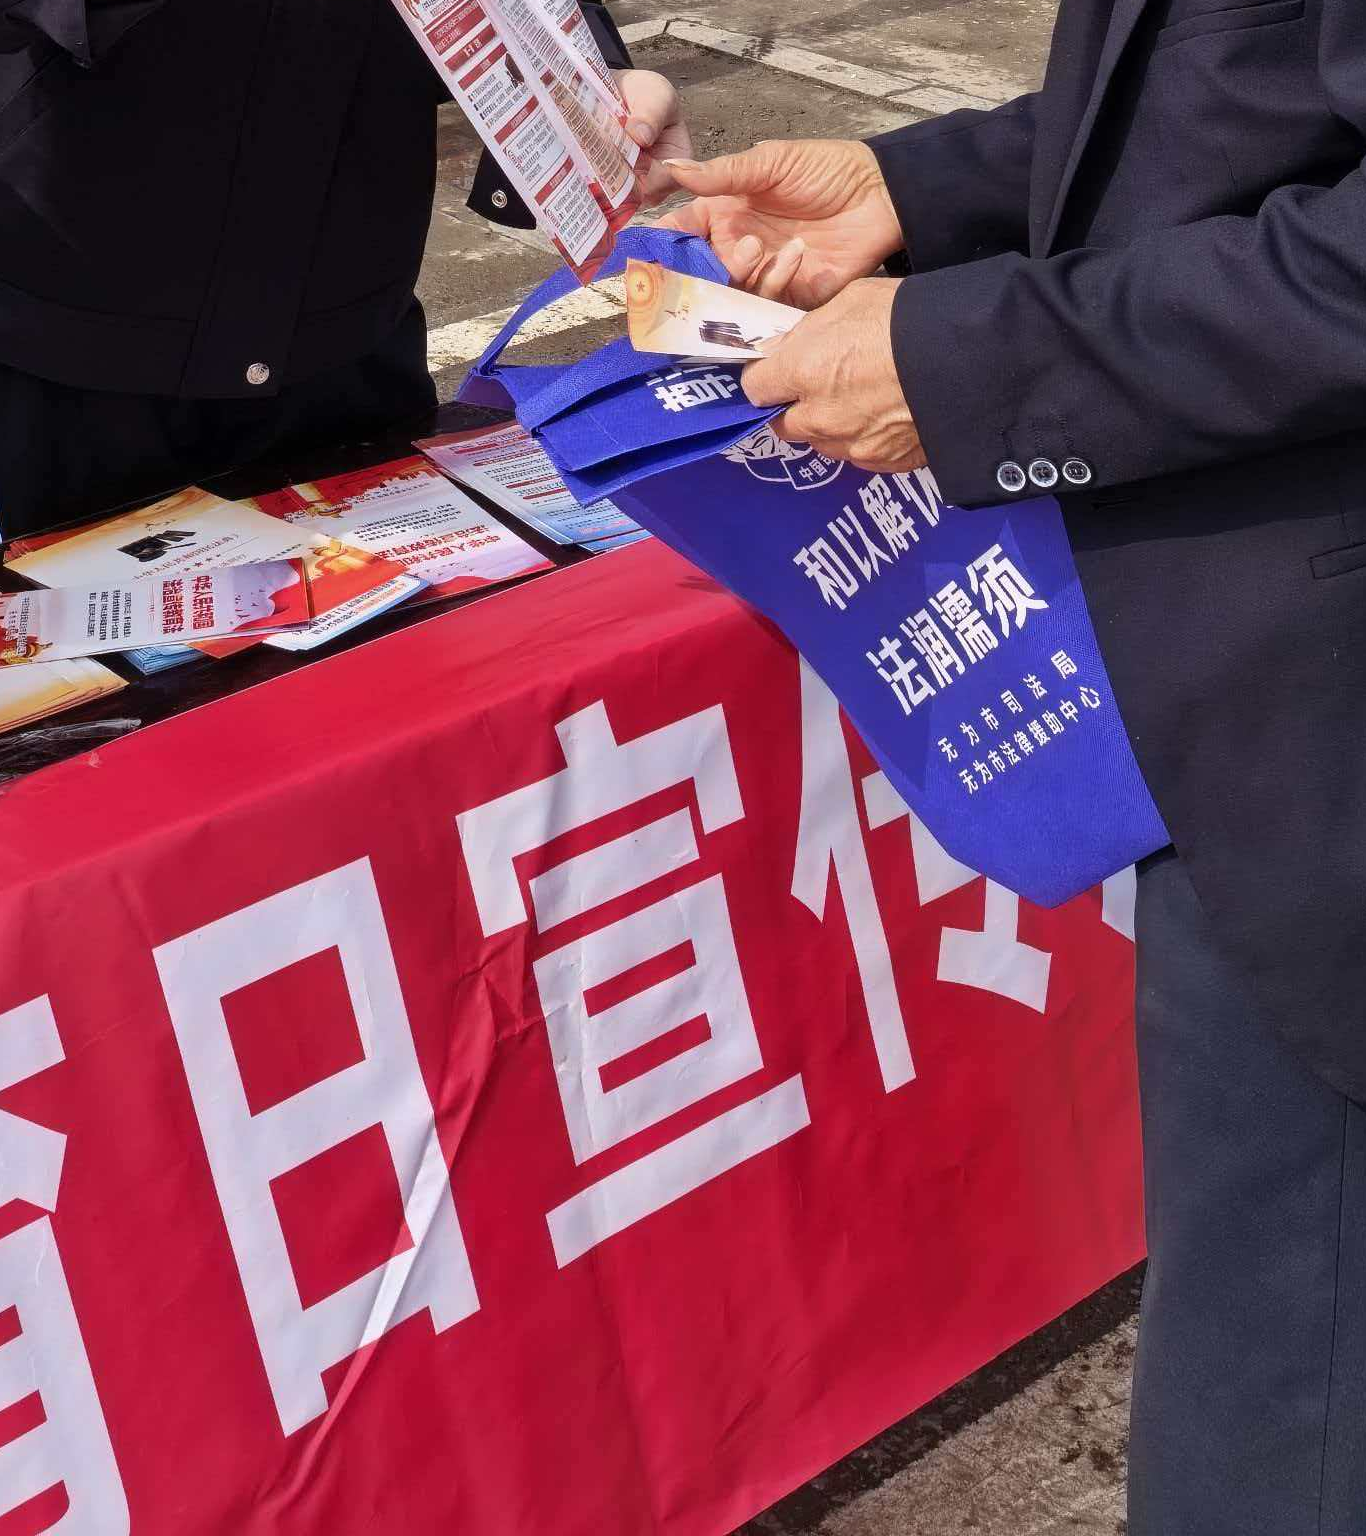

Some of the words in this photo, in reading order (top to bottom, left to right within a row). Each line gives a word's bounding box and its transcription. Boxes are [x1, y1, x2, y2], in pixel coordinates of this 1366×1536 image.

[937, 648, 1079, 764] 无为市司法局
[957, 684, 1103, 795] 无为市法律援助中心
